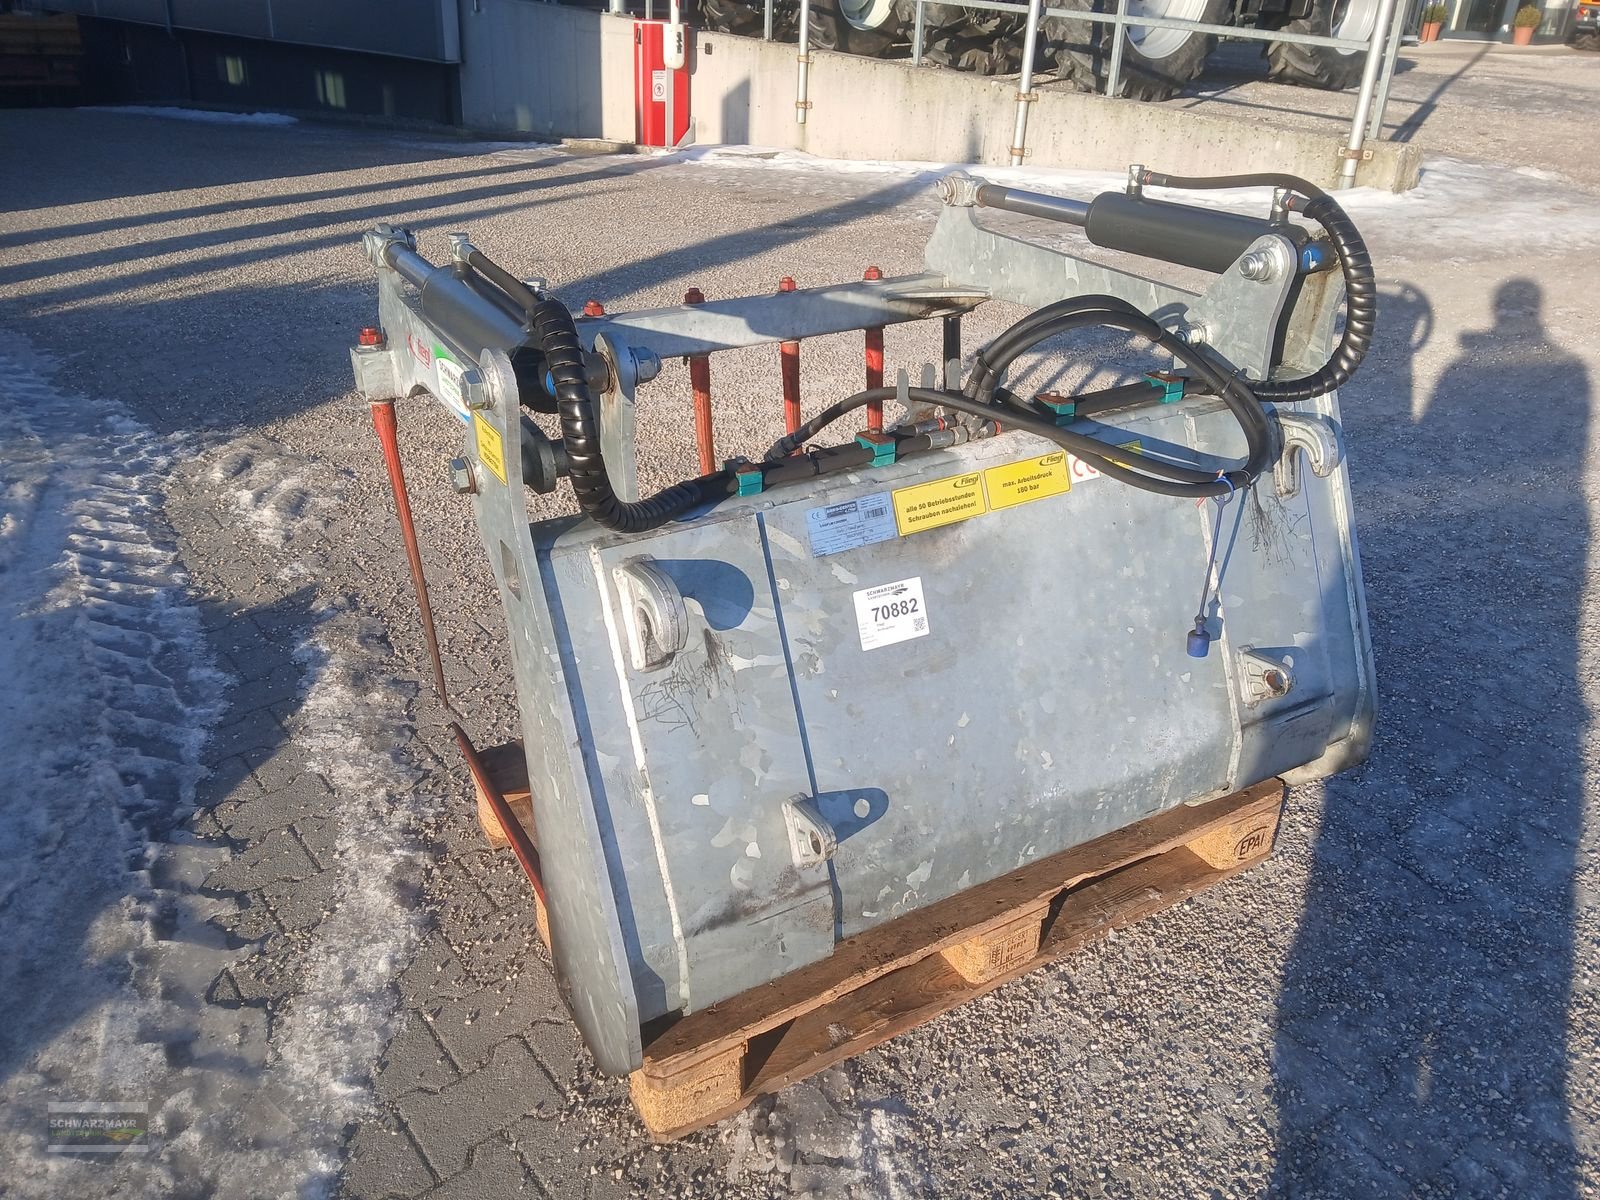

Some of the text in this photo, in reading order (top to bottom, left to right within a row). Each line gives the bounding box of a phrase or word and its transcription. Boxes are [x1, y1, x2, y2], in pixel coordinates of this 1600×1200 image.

[1046, 453, 1063, 464] Fliegl
[960, 474, 979, 486] Fliegl
[1002, 470, 1053, 488] max. Arbeitsdruck
[1017, 483, 1040, 494] 180 bar
[906, 491, 976, 513] alle 50 Betriebsstunden
[908, 500, 977, 523] Schrauben nachziehen!
[866, 583, 905, 597] SCHWARZMAYR
[871, 598, 919, 622] 70882
